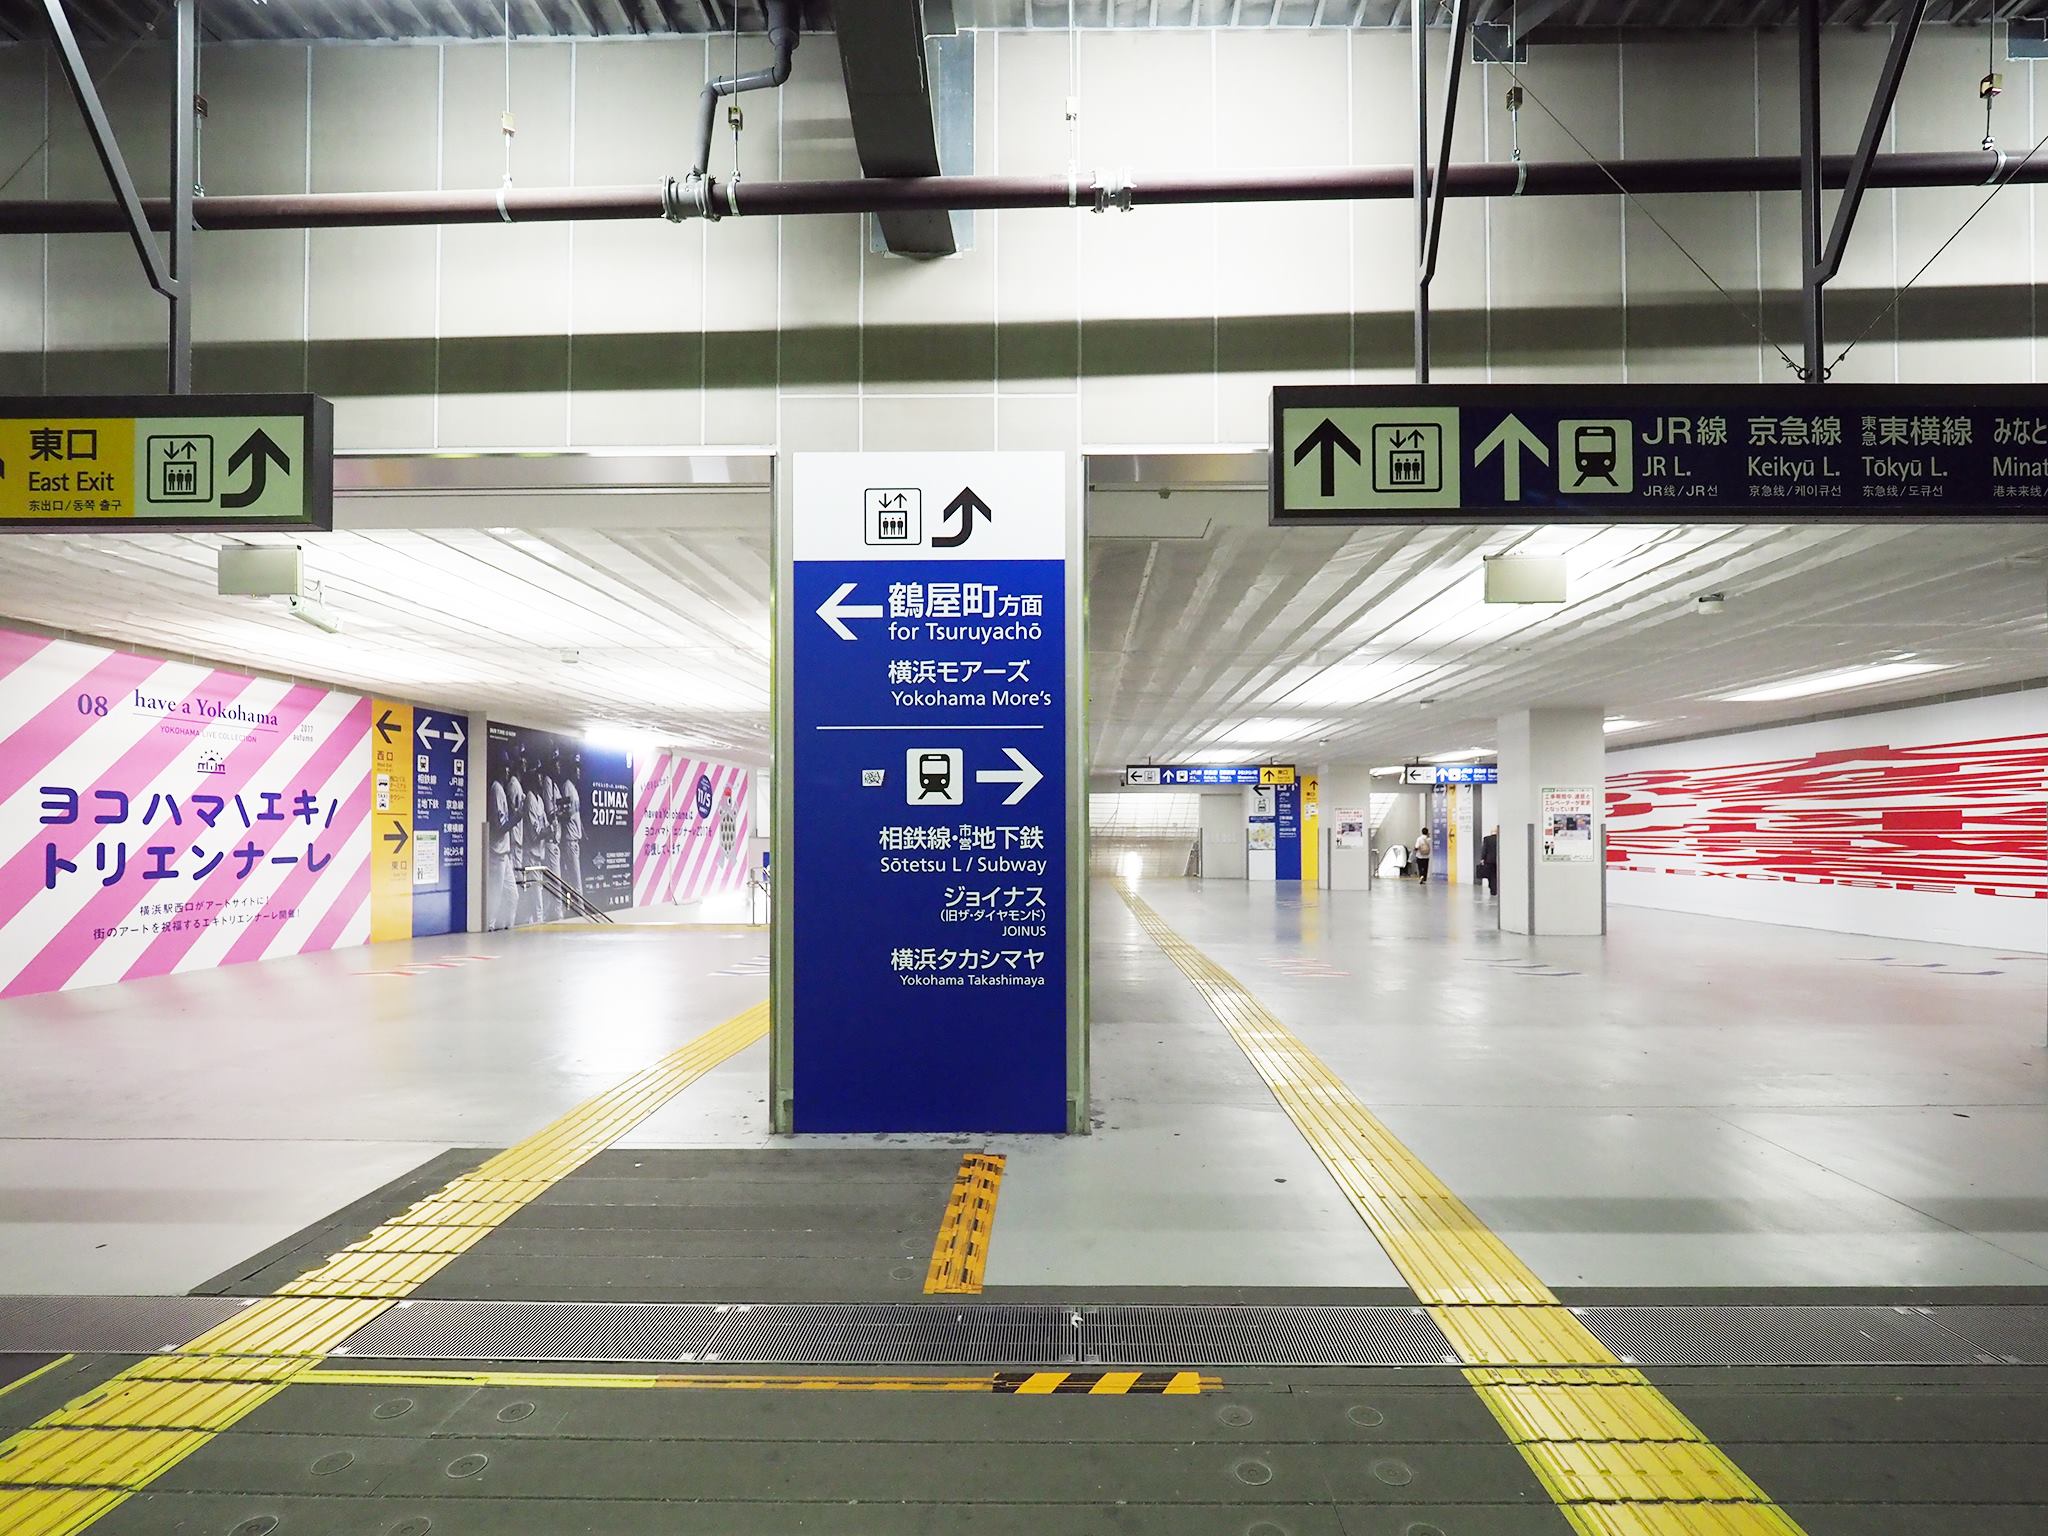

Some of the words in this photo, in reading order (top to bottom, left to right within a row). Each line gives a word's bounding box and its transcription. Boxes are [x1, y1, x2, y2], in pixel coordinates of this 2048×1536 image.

[1642, 416, 1728, 446] JR線
[1748, 416, 1842, 446] 京急線
[1993, 417, 2048, 445] みなと
[29, 427, 98, 461] 東口
[1642, 456, 1667, 477] JR
[1674, 456, 1692, 477] L.
[1748, 456, 1815, 481] Keikyū
[1823, 456, 1841, 477] L.
[1861, 456, 1922, 482] Tōkyū
[1931, 456, 1948, 477] L.
[28, 472, 69, 492] East
[76, 471, 115, 492] Exit
[888, 581, 1043, 619] 鶴屋町方面
[888, 621, 920, 640] for
[928, 620, 1042, 645] Tsuruyachō
[888, 659, 1031, 685] 横浜モアーズ
[77, 693, 109, 717] 08
[135, 689, 176, 712] have
[182, 702, 191, 714] a
[196, 697, 278, 726] Yokohama
[891, 690, 986, 708] Yokohama
[991, 690, 1052, 708] More's
[160, 725, 200, 737] YOKOHAMA
[202, 729, 216, 740] LIVE
[218, 730, 257, 743] COLLECTION
[592, 789, 629, 809] CLIMAX
[592, 808, 615, 826] 2017
[45, 840, 332, 889] トリエンナーレ
[880, 855, 948, 873] Sōtetsu
[951, 856, 962, 873] L
[965, 855, 973, 874] /
[977, 856, 1047, 877] Subway
[944, 886, 1047, 908] ジョイナス
[1001, 925, 1047, 937] JOINUS
[890, 948, 1046, 971] 横浜タカシマヤ
[899, 974, 966, 987] Yokohama
[968, 974, 1045, 988] Takashimaya
